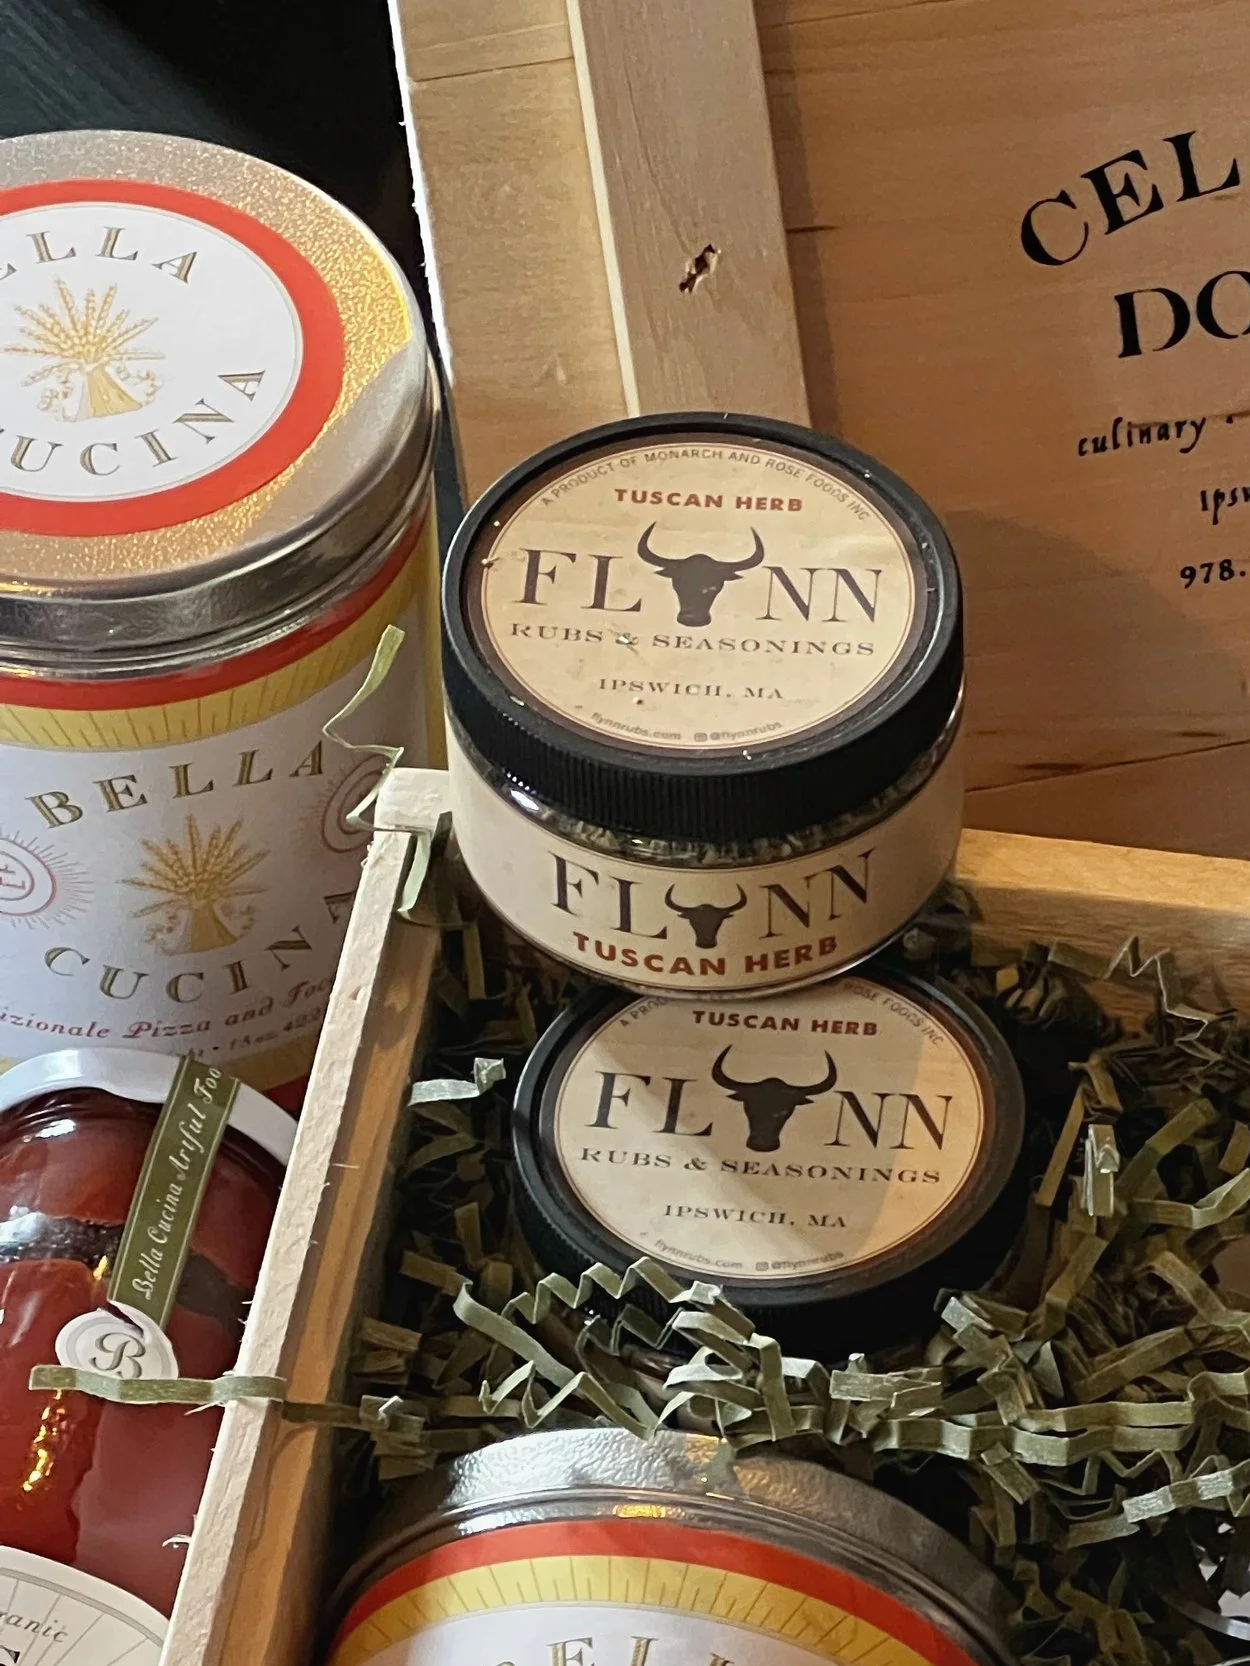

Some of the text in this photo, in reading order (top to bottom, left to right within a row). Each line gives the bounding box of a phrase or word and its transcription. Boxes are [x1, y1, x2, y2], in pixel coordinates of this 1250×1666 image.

[0, 227, 197, 284] LLA
[0, 370, 265, 476] UCINA
[1078, 417, 1206, 456] culinary
[552, 463, 615, 497] PRODUCT
[620, 456, 637, 468] OF
[644, 448, 723, 463] MONARCH
[728, 452, 760, 464] AND
[765, 458, 801, 478] ROSE
[805, 473, 850, 503] FOODS
[614, 488, 802, 512] TUSCAN HERB
[510, 622, 603, 644] RUBS
[652, 633, 876, 657] SEASONINGS
[744, 687, 783, 699] MA
[24, 739, 324, 829] BELLA
[572, 931, 838, 976] TUSCAN HERB
[0, 996, 274, 1039] izionale Pizza and
[692, 1011, 878, 1036] TUSCAN HERB
[194, 1067, 222, 1104] Foo
[581, 1146, 942, 1185] RUBS & SEASONINGS
[147, 1183, 182, 1244] Cucina
[808, 1214, 846, 1228] MA
[132, 1249, 163, 1300] Bella
[0, 1611, 68, 1643] anic
